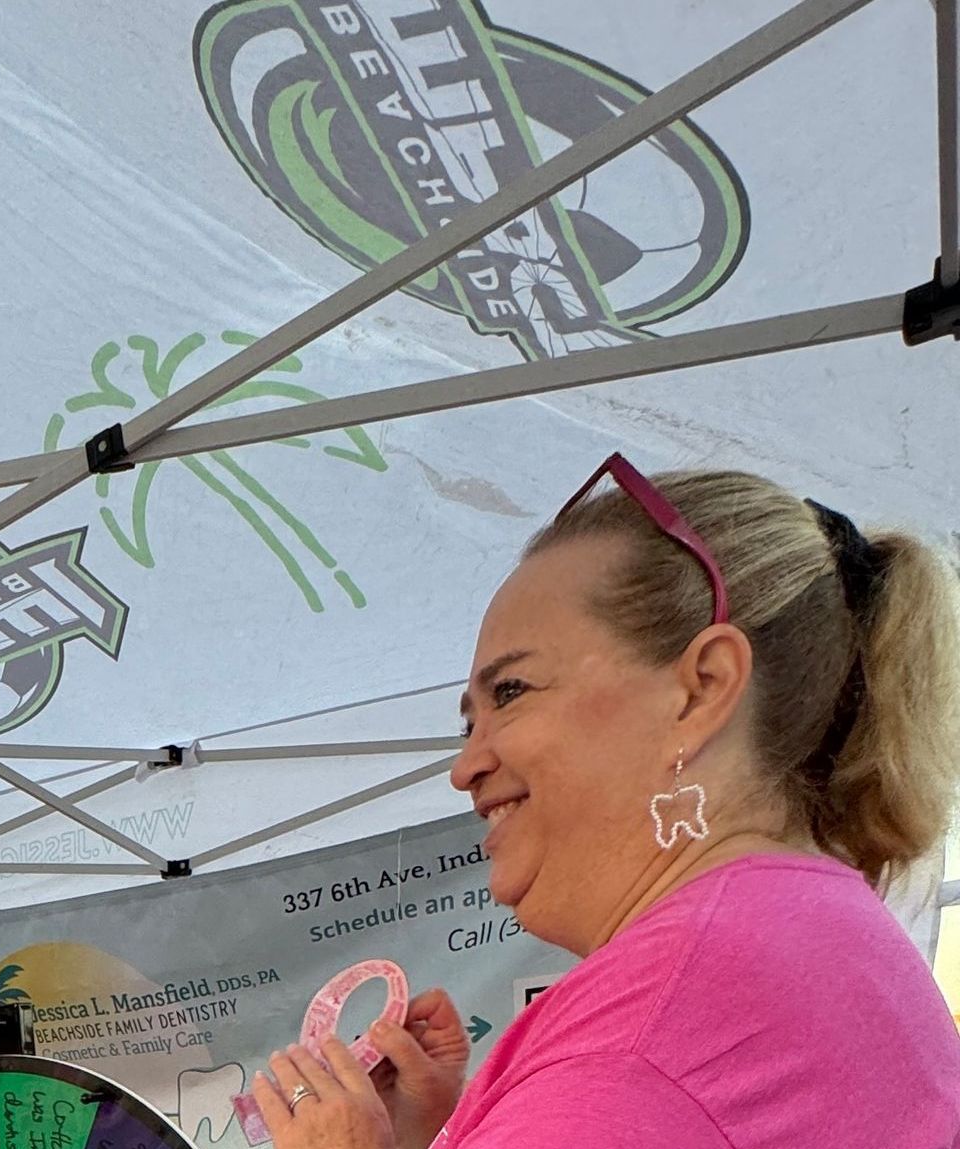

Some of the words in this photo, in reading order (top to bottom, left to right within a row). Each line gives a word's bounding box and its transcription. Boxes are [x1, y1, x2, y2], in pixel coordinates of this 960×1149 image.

[283, 887, 323, 913] 337
[330, 876, 370, 903] 6th
[377, 863, 432, 891] Ave,
[437, 843, 490, 873] Ind
[309, 902, 418, 943] Schedule
[425, 895, 455, 916] an
[462, 886, 501, 911] ap
[448, 920, 492, 952] Call
[498, 915, 530, 942] (3
[32, 1000, 89, 1023] Jessica
[91, 996, 110, 1017] L.
[215, 973, 257, 993] DDS,
[257, 968, 280, 984] PA
[36, 1023, 105, 1044] BEACHSIDE
[106, 1017, 155, 1036] FAMILY
[159, 998, 238, 1029] DENTISTRY
[109, 1041, 120, 1056] &
[123, 1035, 172, 1056] Family
[175, 1029, 213, 1048] Care
[32, 1091, 46, 1122] was
